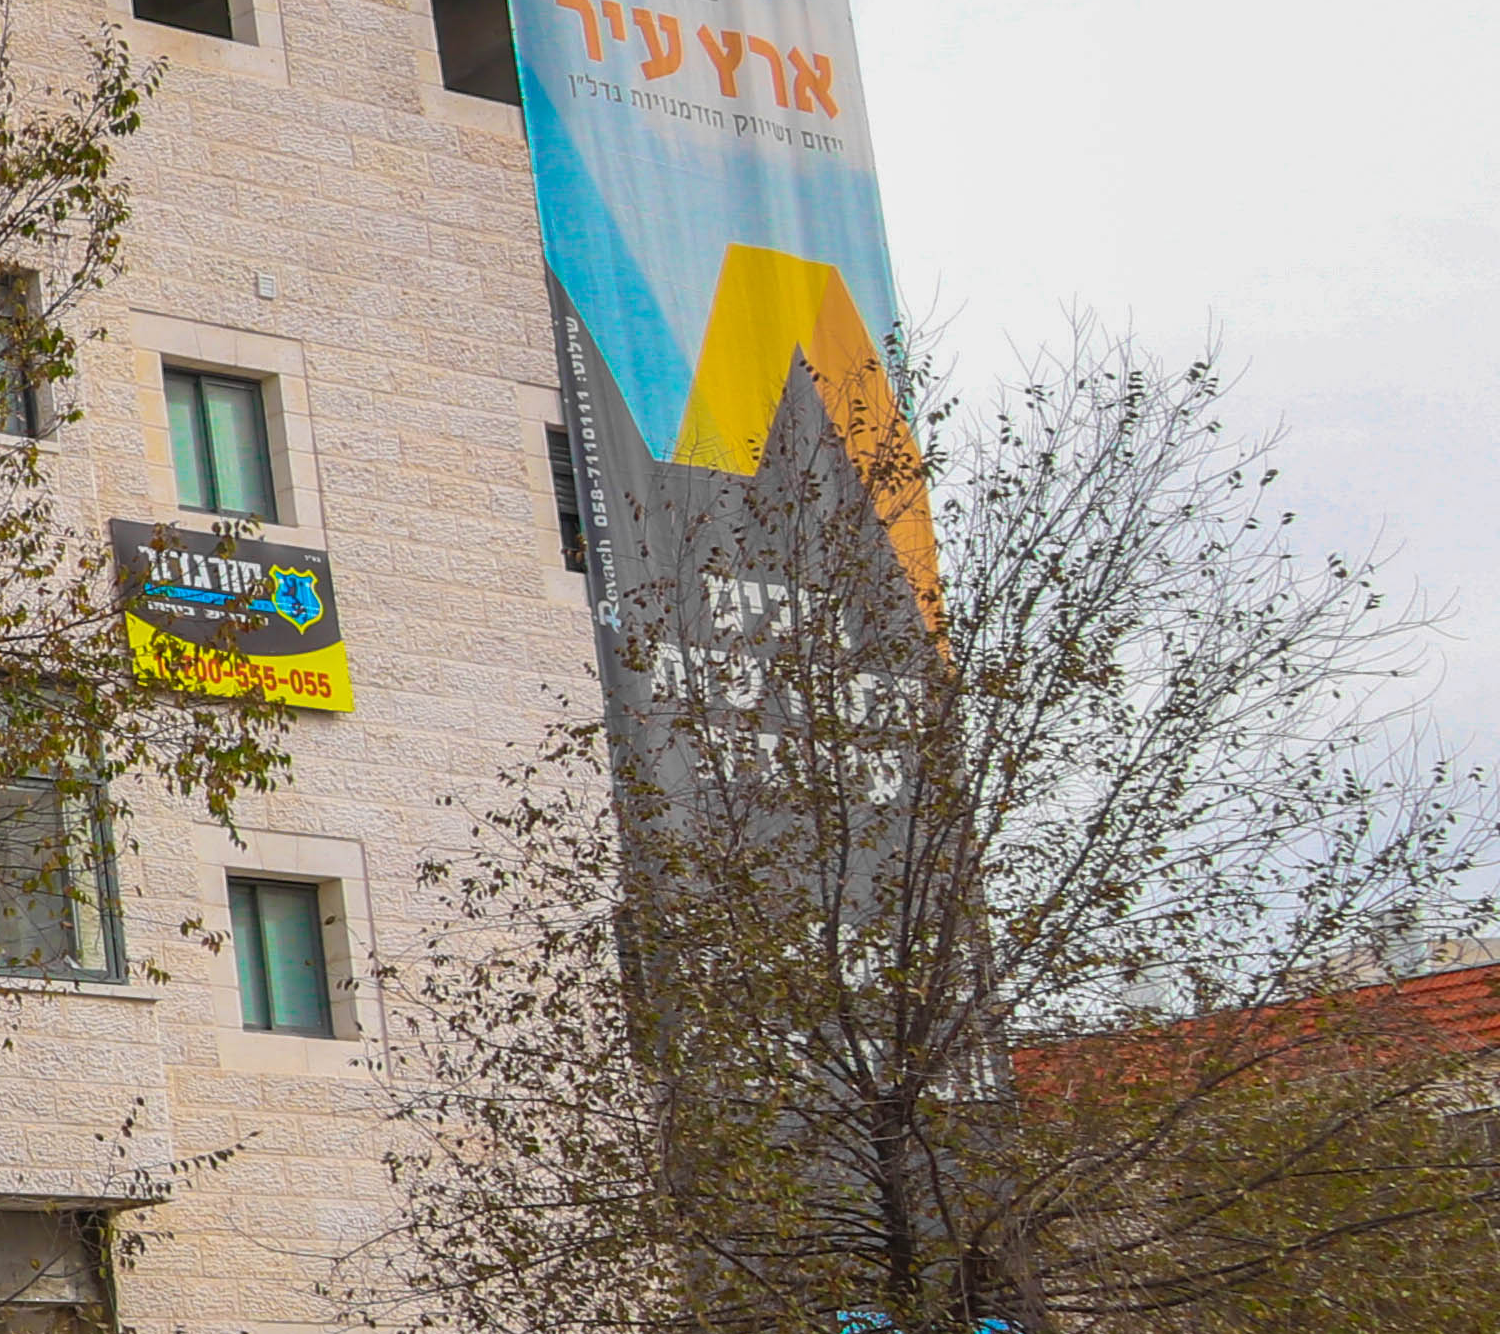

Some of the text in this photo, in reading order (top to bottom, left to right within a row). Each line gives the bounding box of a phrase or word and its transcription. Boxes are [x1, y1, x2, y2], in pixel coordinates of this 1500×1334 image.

[568, 73, 845, 152] ייזום ושיווק הזדמנויות נדל"ן
[695, 21, 838, 120] ארץ
[595, 539, 622, 634] Revach
